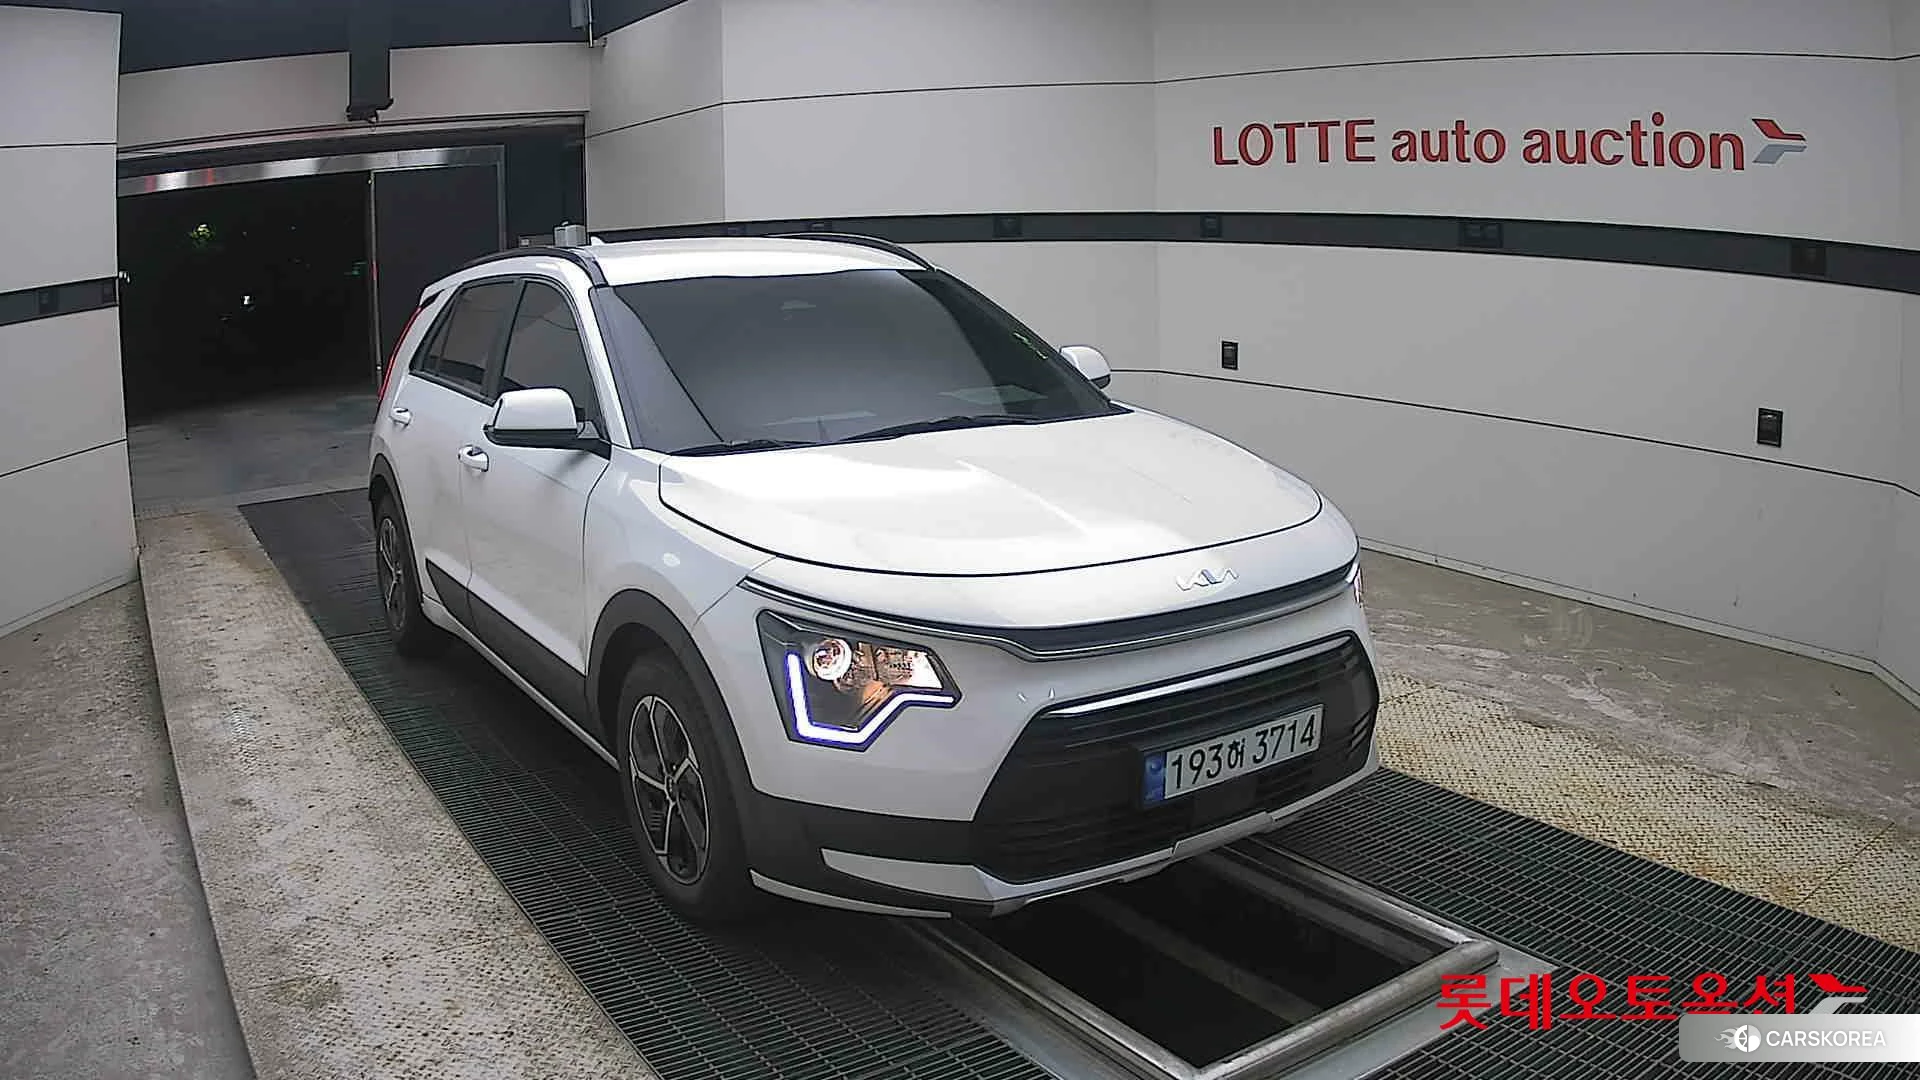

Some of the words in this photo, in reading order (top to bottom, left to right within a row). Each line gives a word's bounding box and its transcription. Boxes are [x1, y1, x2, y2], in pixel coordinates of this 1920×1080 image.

[1213, 119, 1376, 166] LOTTE
[1391, 119, 1507, 164] auto
[1522, 111, 1745, 171] auction
[1252, 714, 1316, 764] 3714
